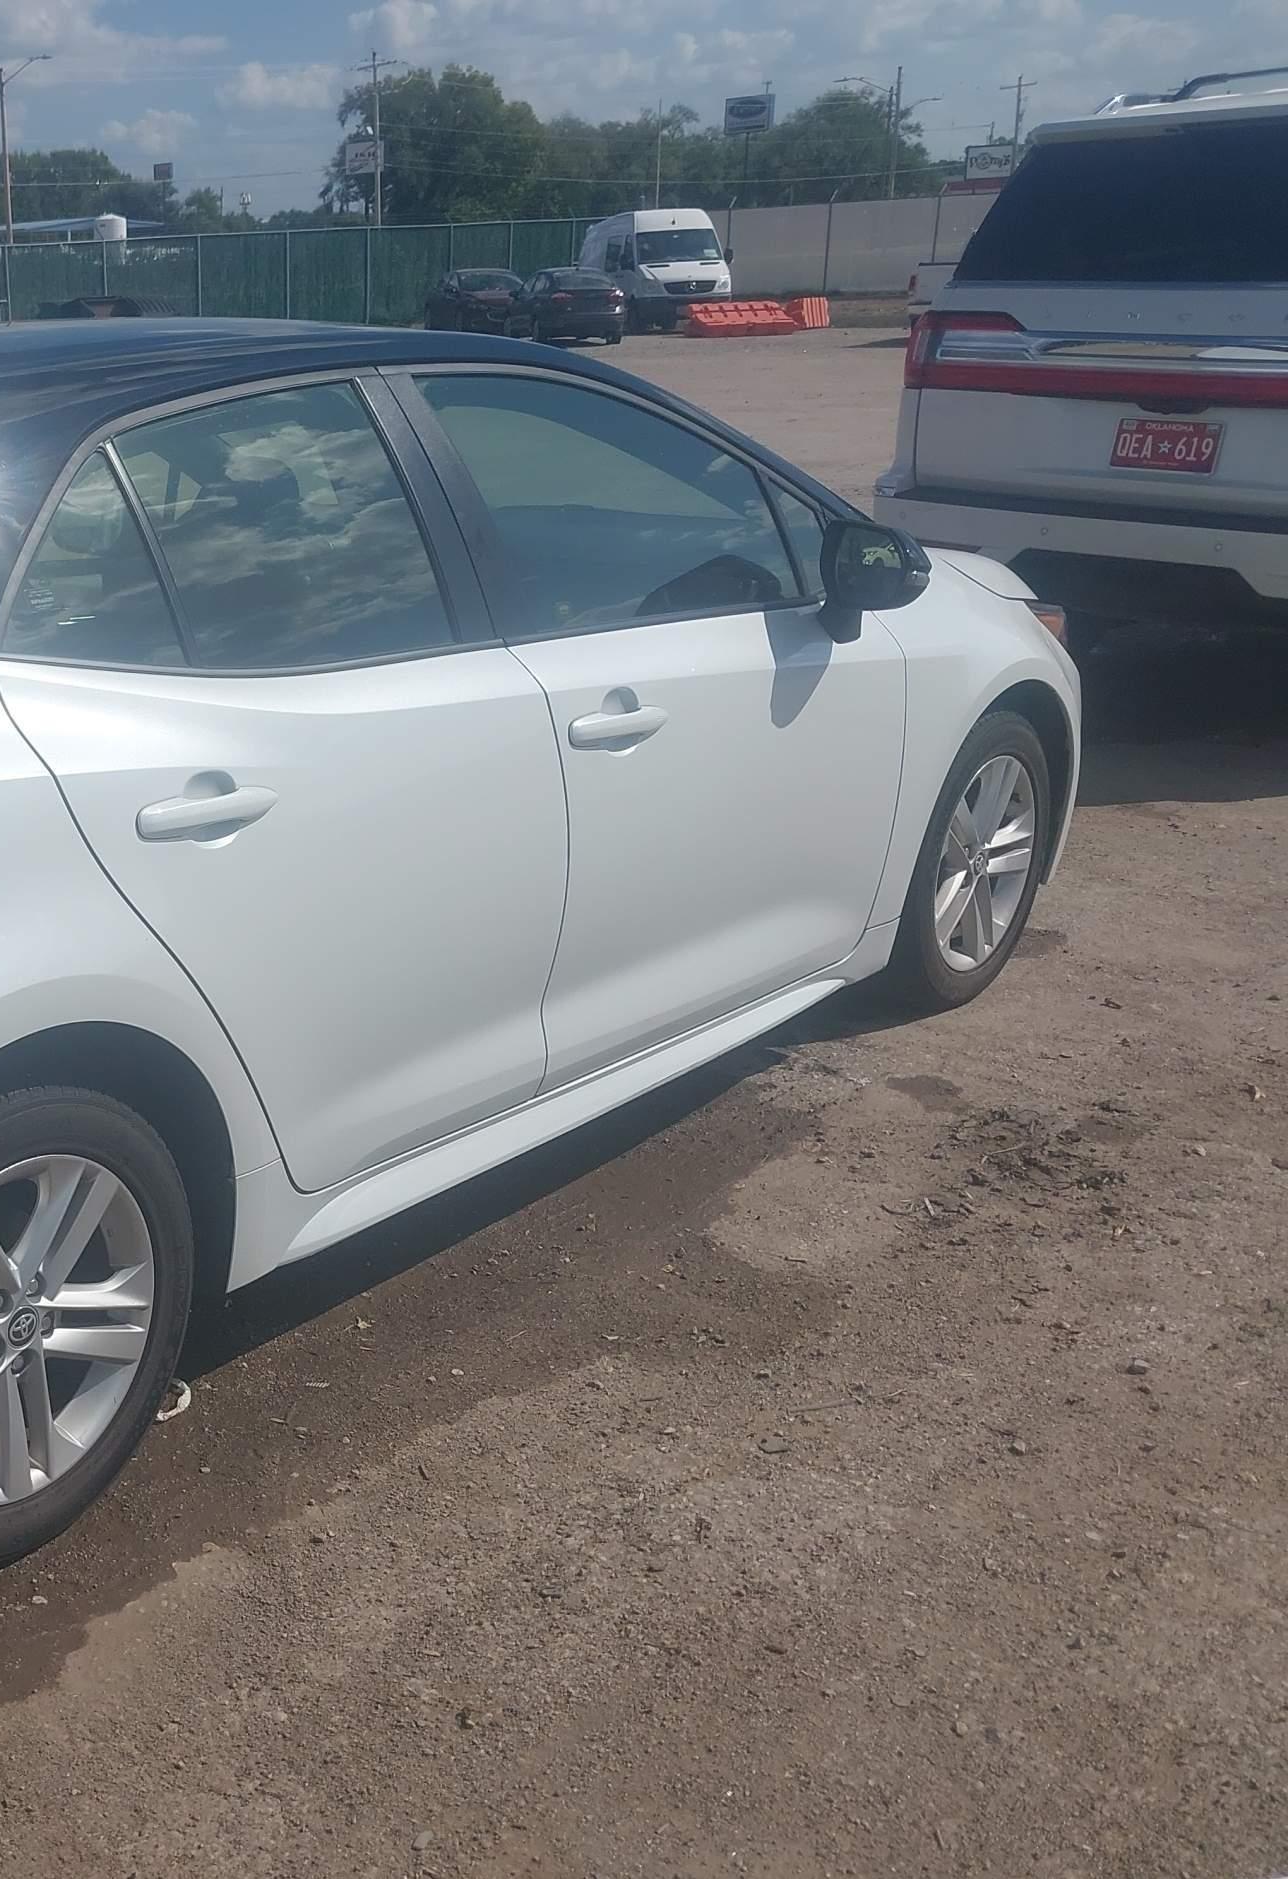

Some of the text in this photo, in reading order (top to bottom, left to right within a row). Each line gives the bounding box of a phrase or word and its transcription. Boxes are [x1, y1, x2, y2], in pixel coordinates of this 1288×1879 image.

[1144, 422, 1194, 432] OKLAHOMA
[1116, 432, 1214, 461] QEA 619
